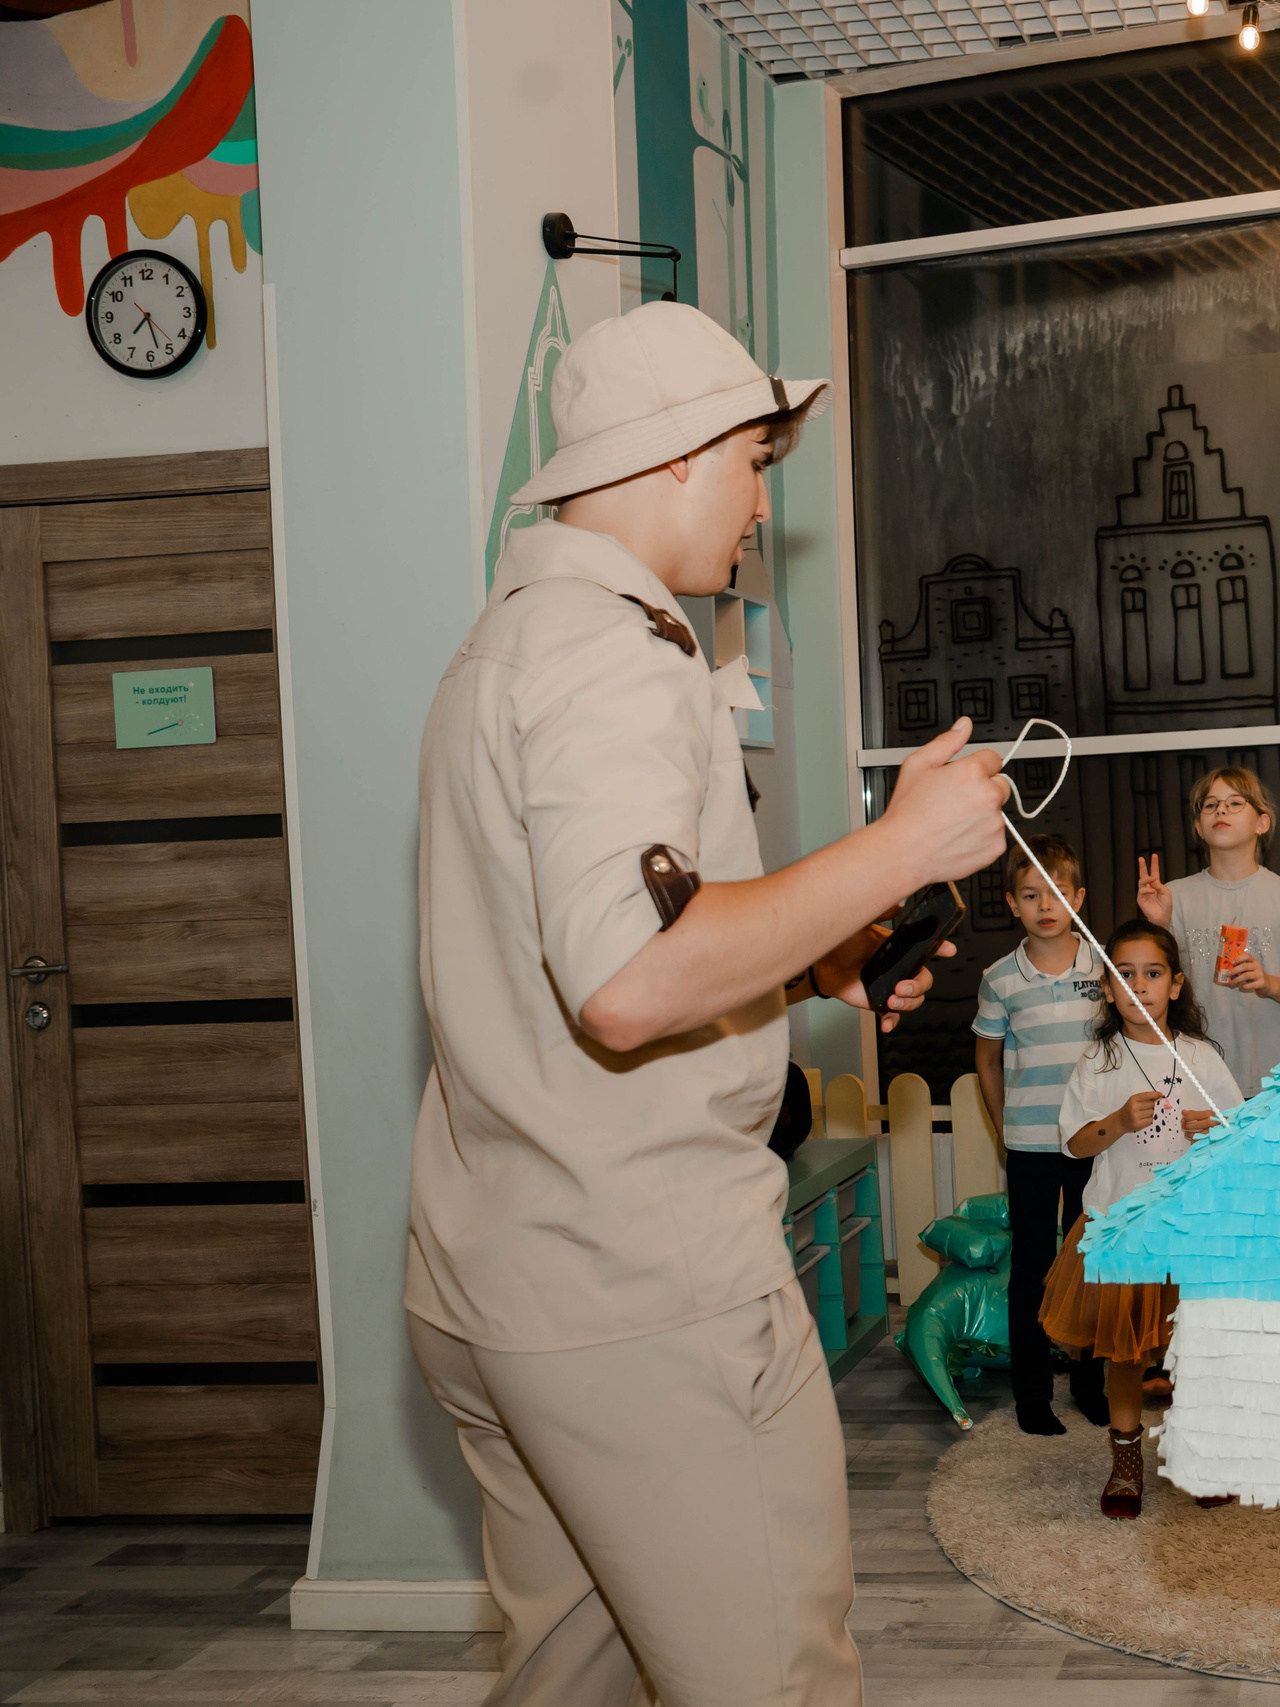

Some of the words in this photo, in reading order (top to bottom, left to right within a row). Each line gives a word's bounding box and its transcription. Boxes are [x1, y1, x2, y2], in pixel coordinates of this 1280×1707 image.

[121, 275, 133, 287] 11
[138, 268, 154, 281] 12
[162, 273, 170, 285] 1
[109, 290, 124, 303] 10
[175, 285, 185, 297] 2
[105, 311, 114, 323] 9
[182, 306, 192, 319] 3
[113, 332, 122, 345] 8
[177, 327, 187, 340] 4
[127, 346, 136, 359] 7
[165, 343, 174, 356] 5
[146, 350, 155, 363] 6
[133, 686, 146, 695] Не
[148, 685, 189, 694] входить
[142, 695, 187, 705] колдуют!
